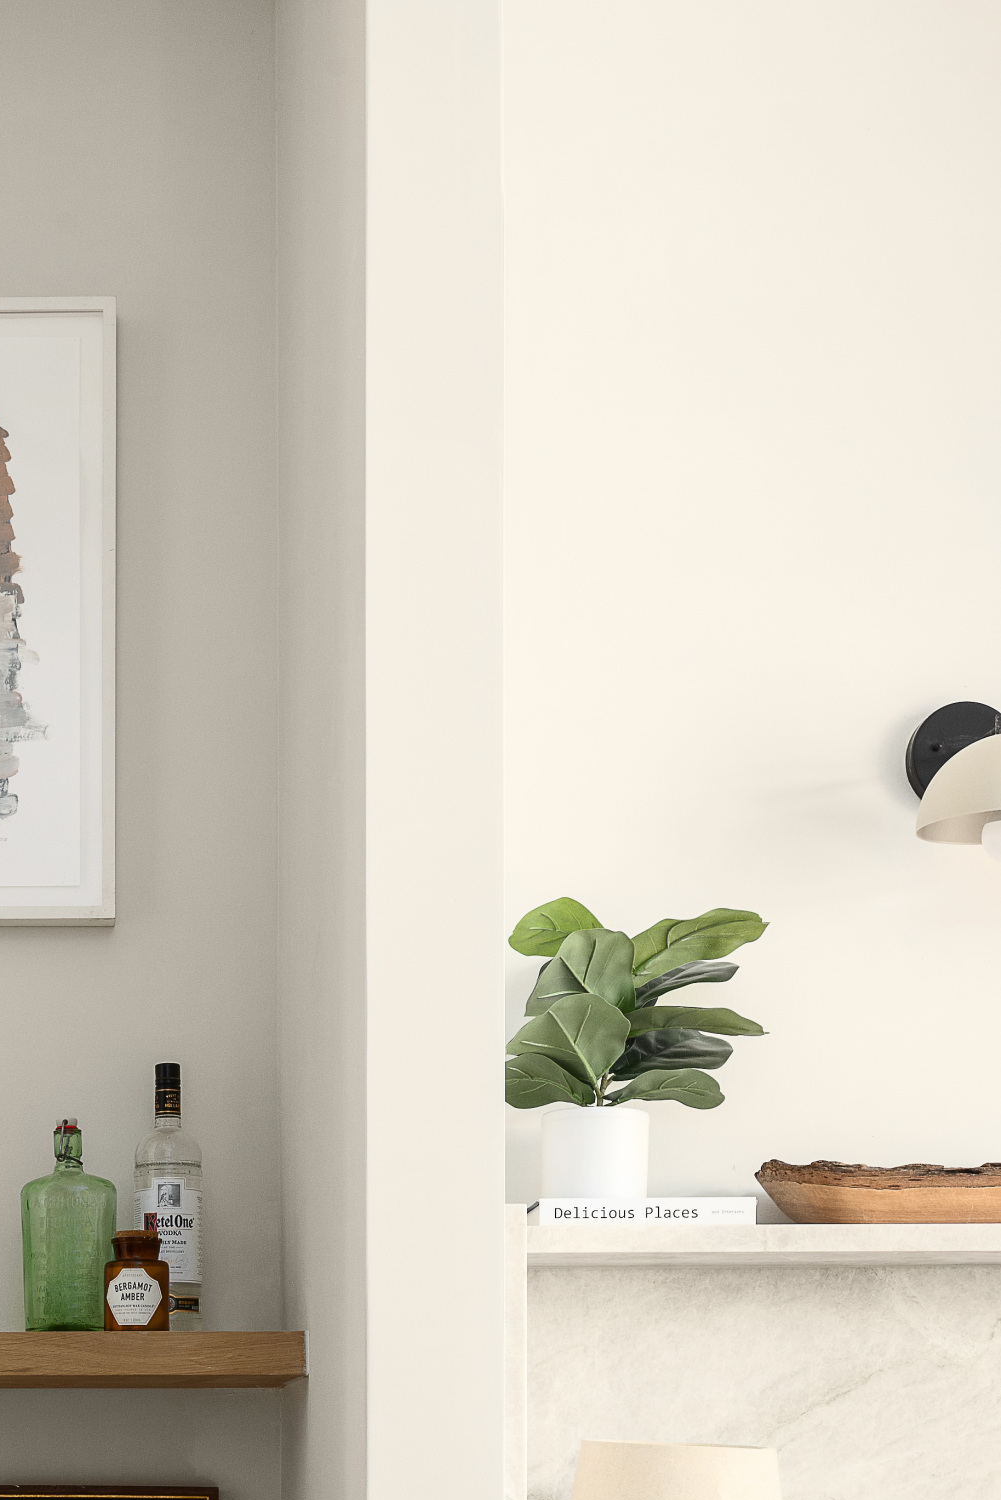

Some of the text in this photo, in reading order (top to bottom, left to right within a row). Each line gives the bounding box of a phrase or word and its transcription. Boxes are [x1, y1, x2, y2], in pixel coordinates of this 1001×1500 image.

[554, 1206, 635, 1219] Delicious
[645, 1206, 699, 1219] Places
[144, 1213, 174, 1231] Ketel
[174, 1214, 193, 1229] One
[114, 1281, 152, 1292] BERGAMOT
[120, 1292, 145, 1301] AMBER
